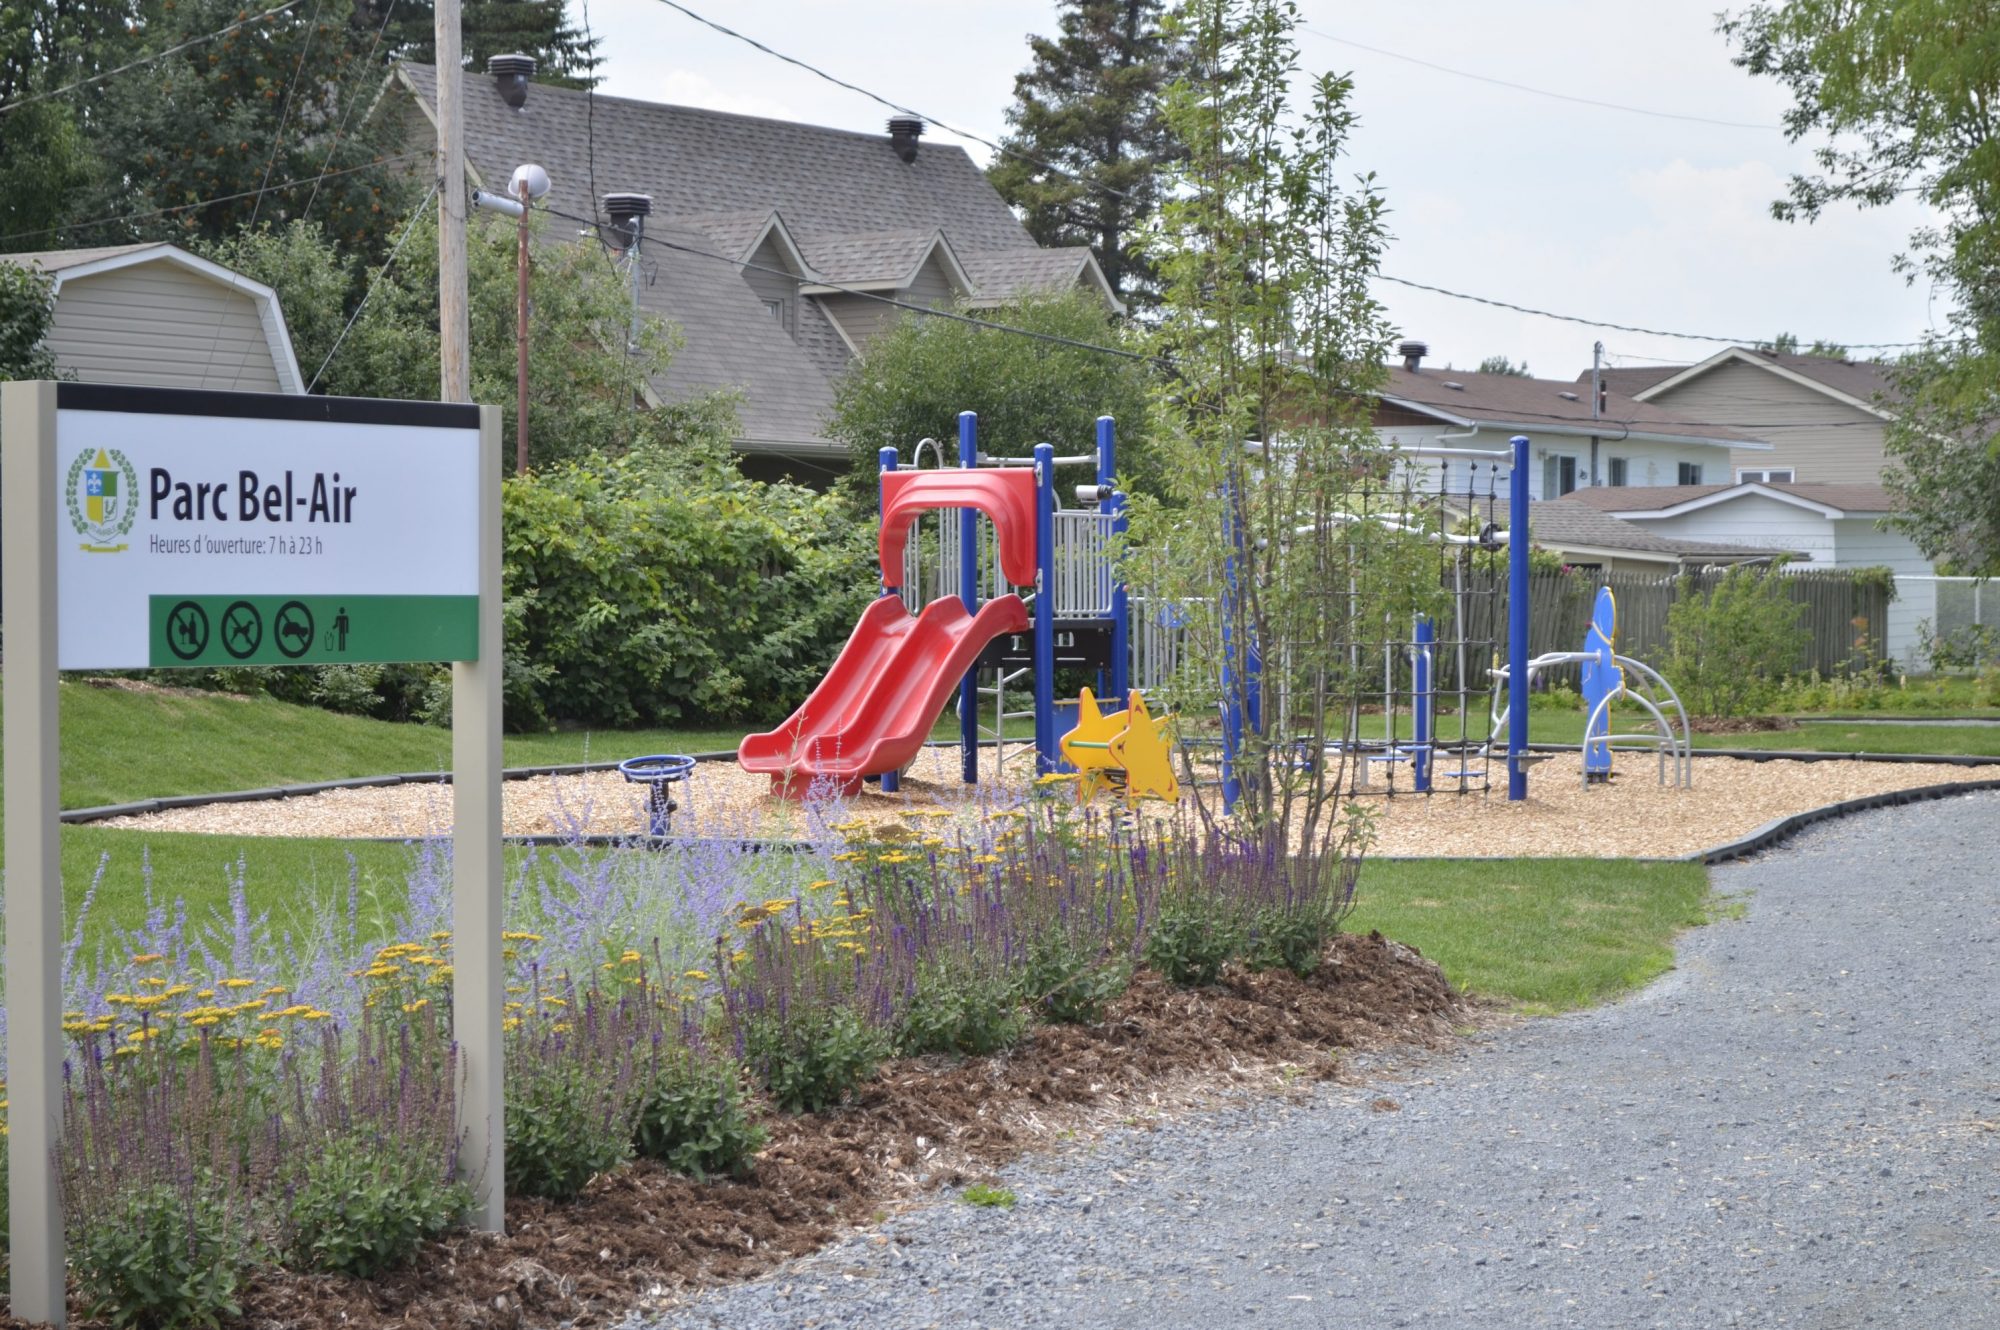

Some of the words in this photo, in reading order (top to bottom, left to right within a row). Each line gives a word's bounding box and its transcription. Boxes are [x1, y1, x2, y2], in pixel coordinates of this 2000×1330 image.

[150, 467, 228, 522] Parc
[238, 470, 358, 524] Bel-Air
[149, 533, 191, 555] Heures
[268, 535, 276, 555] 7
[279, 535, 287, 555] h
[289, 535, 296, 555] à
[298, 535, 313, 555] 23
[315, 535, 323, 555] h
